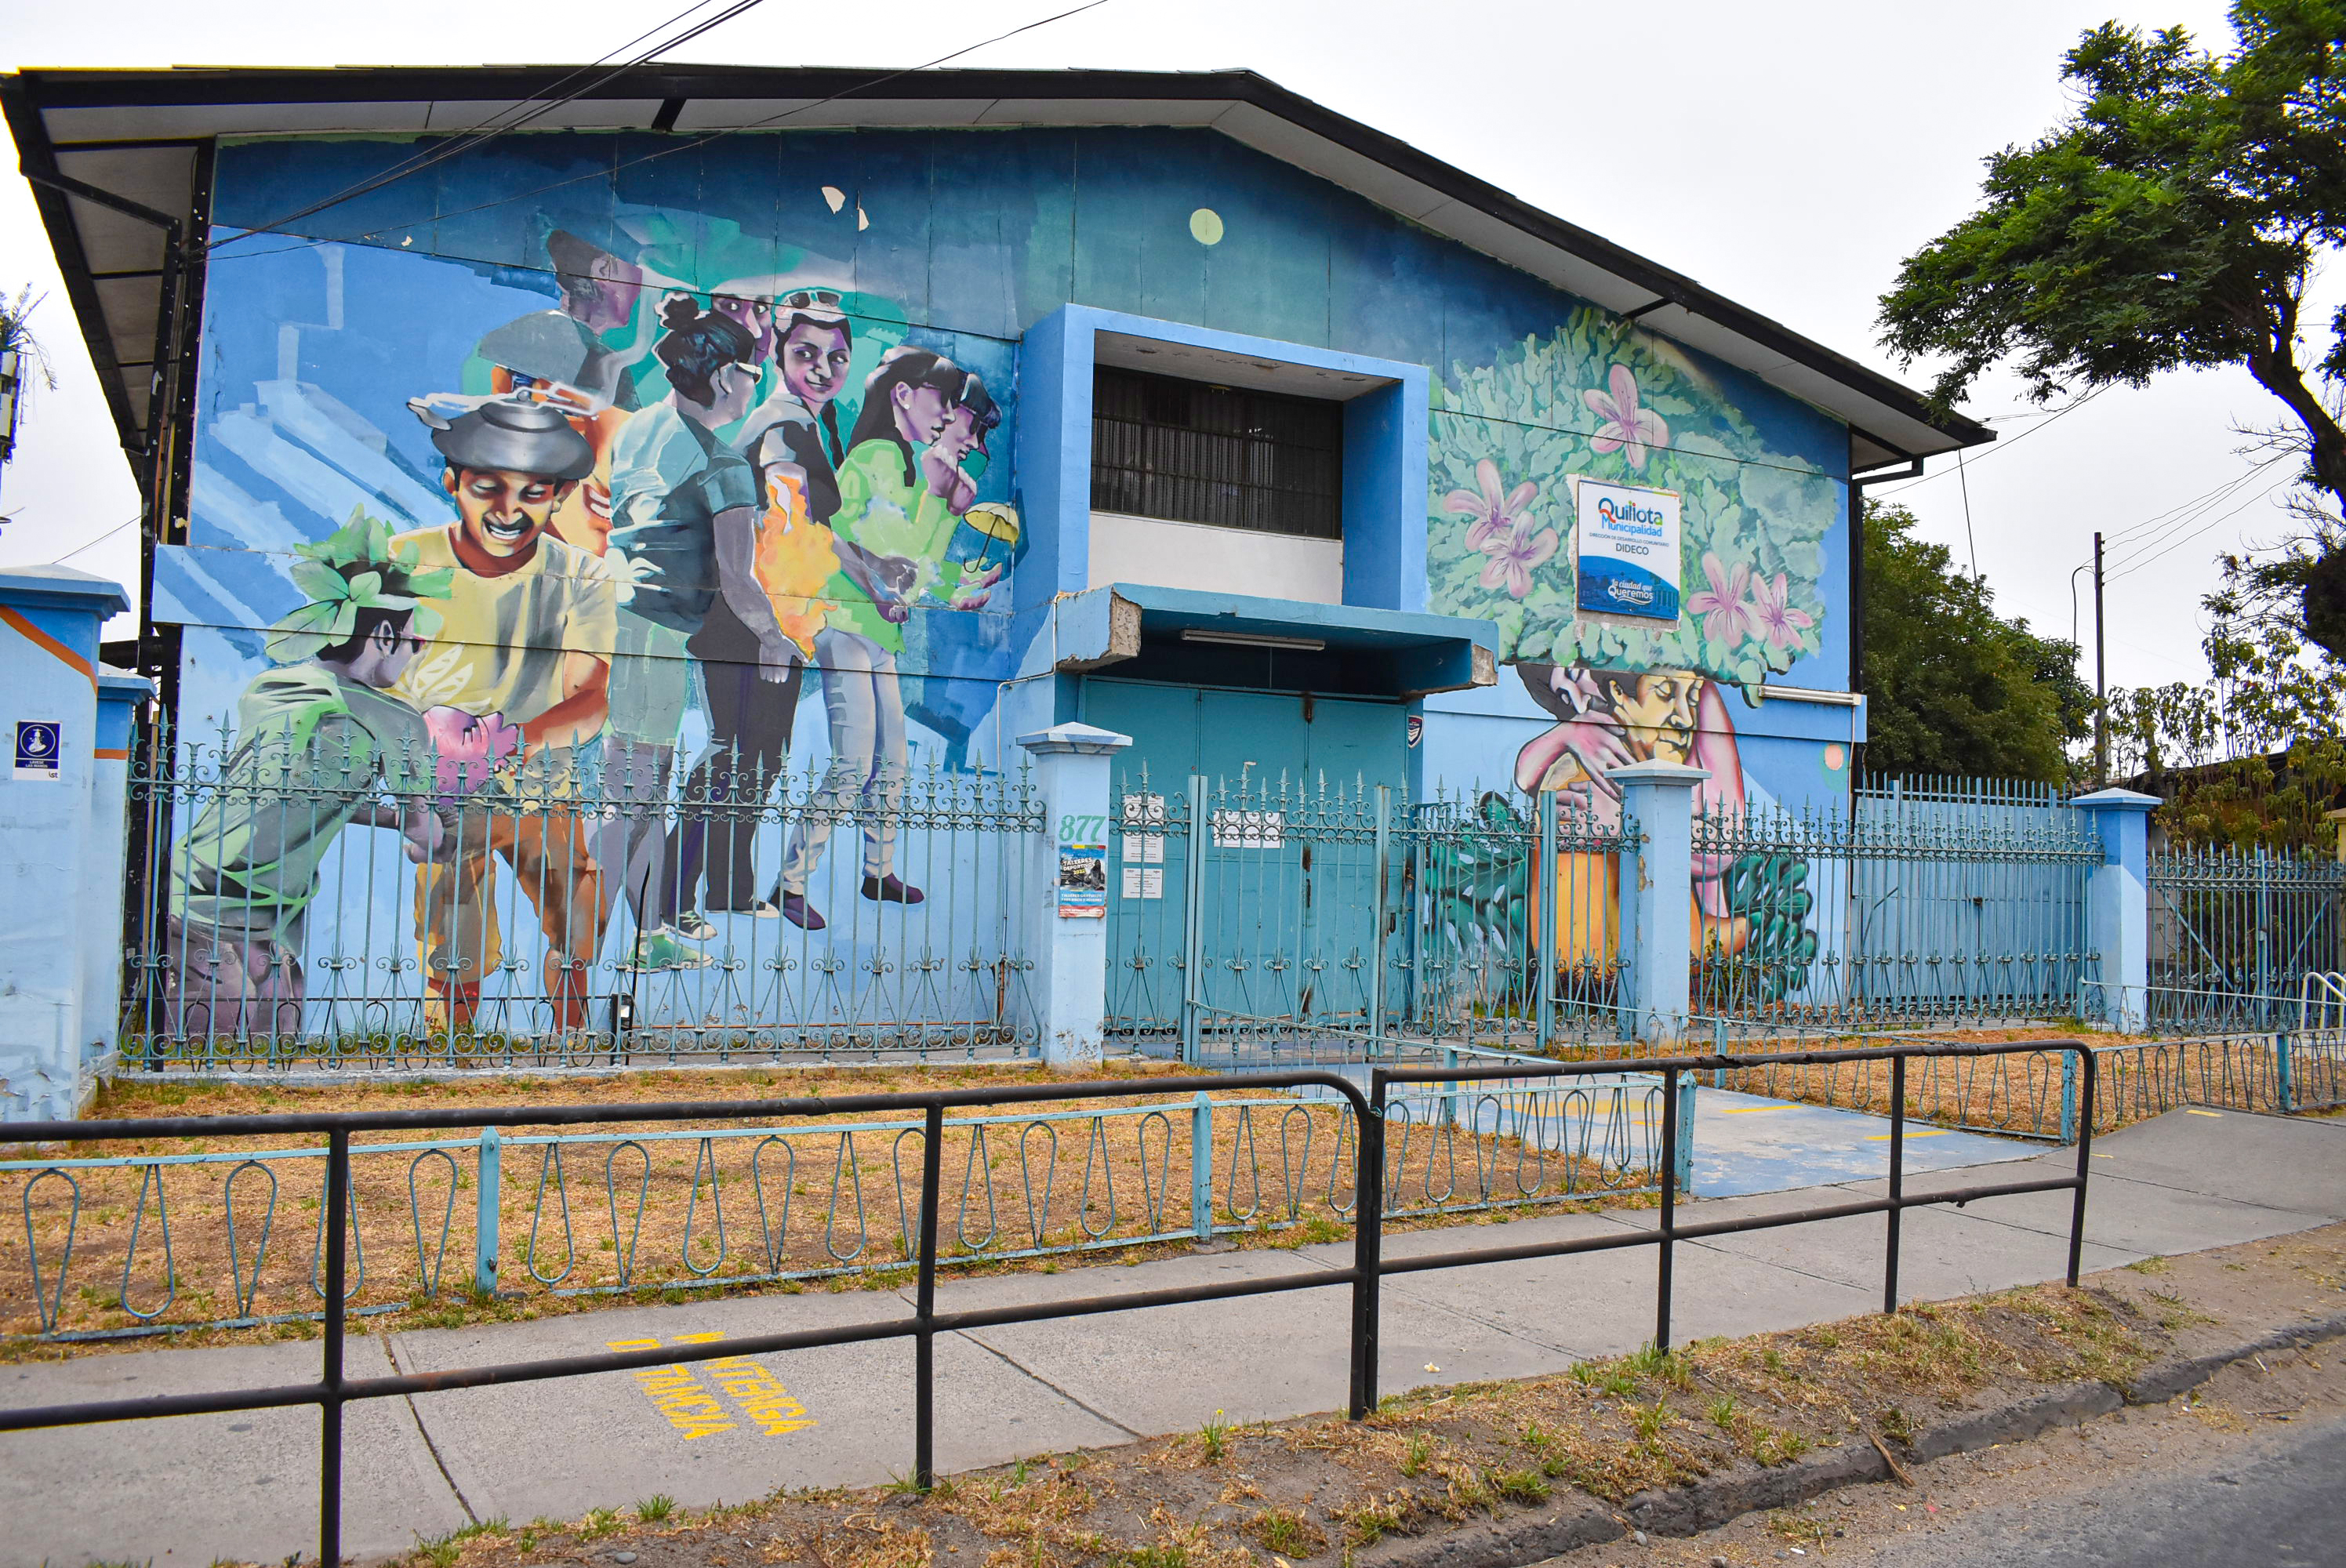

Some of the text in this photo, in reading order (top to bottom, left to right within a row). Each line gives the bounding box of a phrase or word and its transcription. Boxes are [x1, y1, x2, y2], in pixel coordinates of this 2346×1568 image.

[1601, 514, 1662, 537] Municipalidad
[1615, 543, 1649, 555] DIDECO
[1608, 585, 1654, 600] Queremos
[1059, 815, 1106, 842] 877
[1063, 857, 1092, 866] TALLERES
[1063, 862, 1095, 872] DEPORTIVOS
[605, 1338, 740, 1440] DTANCIA
[672, 1330, 819, 1436] MNTENGA
